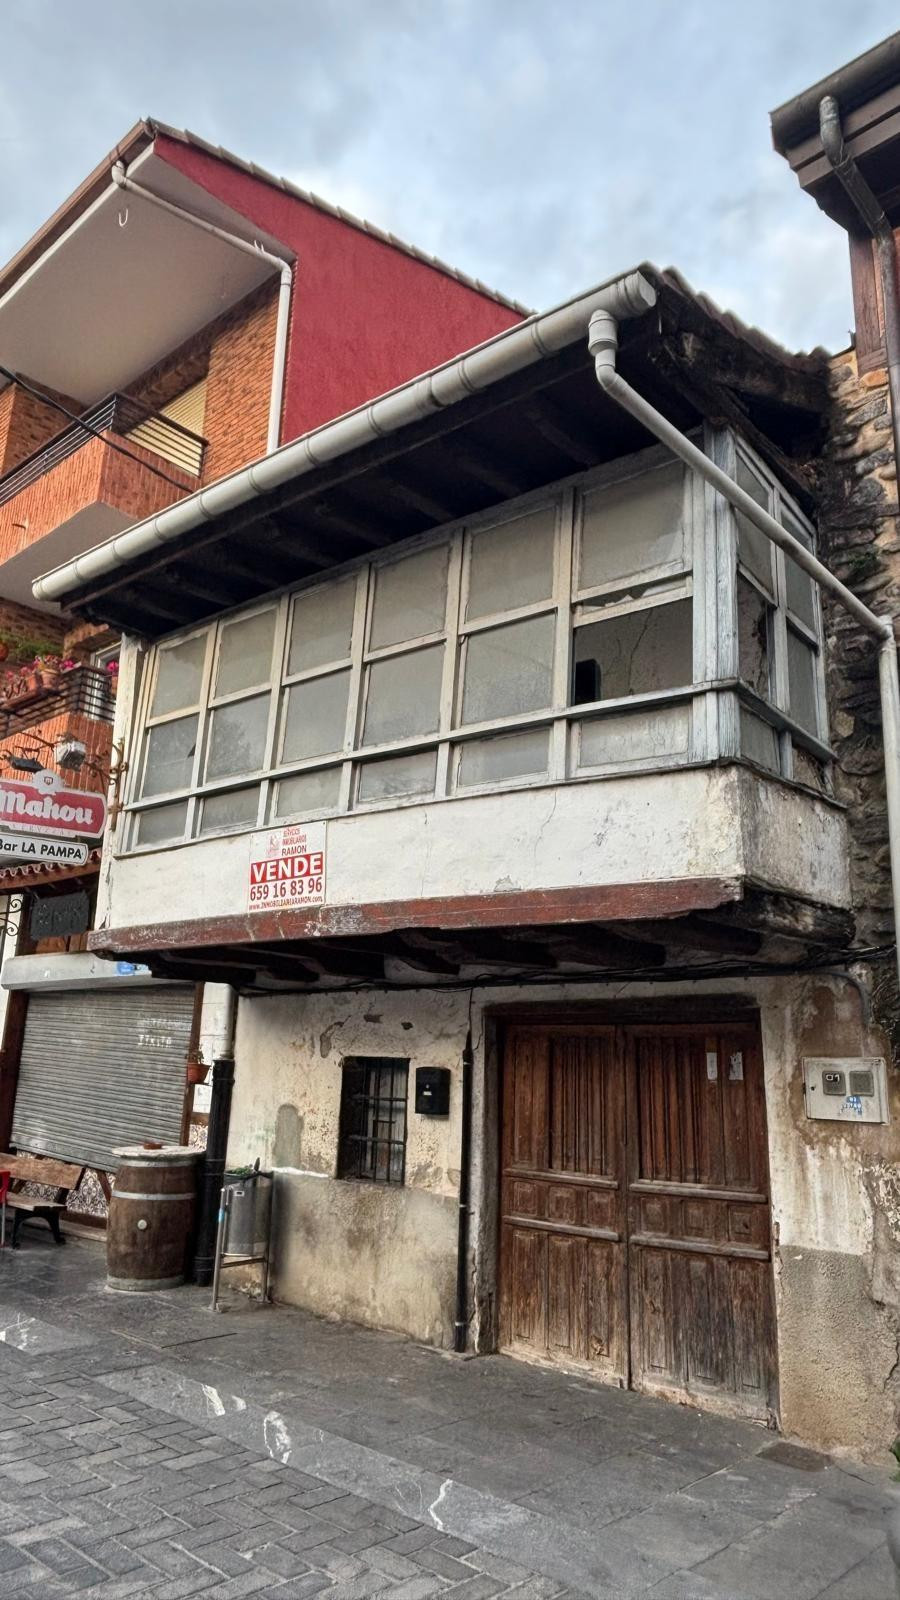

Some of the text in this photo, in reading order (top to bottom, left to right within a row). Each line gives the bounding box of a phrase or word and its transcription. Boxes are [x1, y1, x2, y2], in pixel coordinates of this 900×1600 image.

[0, 789, 93, 825] Mahou
[22, 842, 36, 854] LA
[40, 844, 82, 859] PAMPA
[252, 854, 322, 882] VENDE
[250, 877, 322, 901] 659 16 83 96
